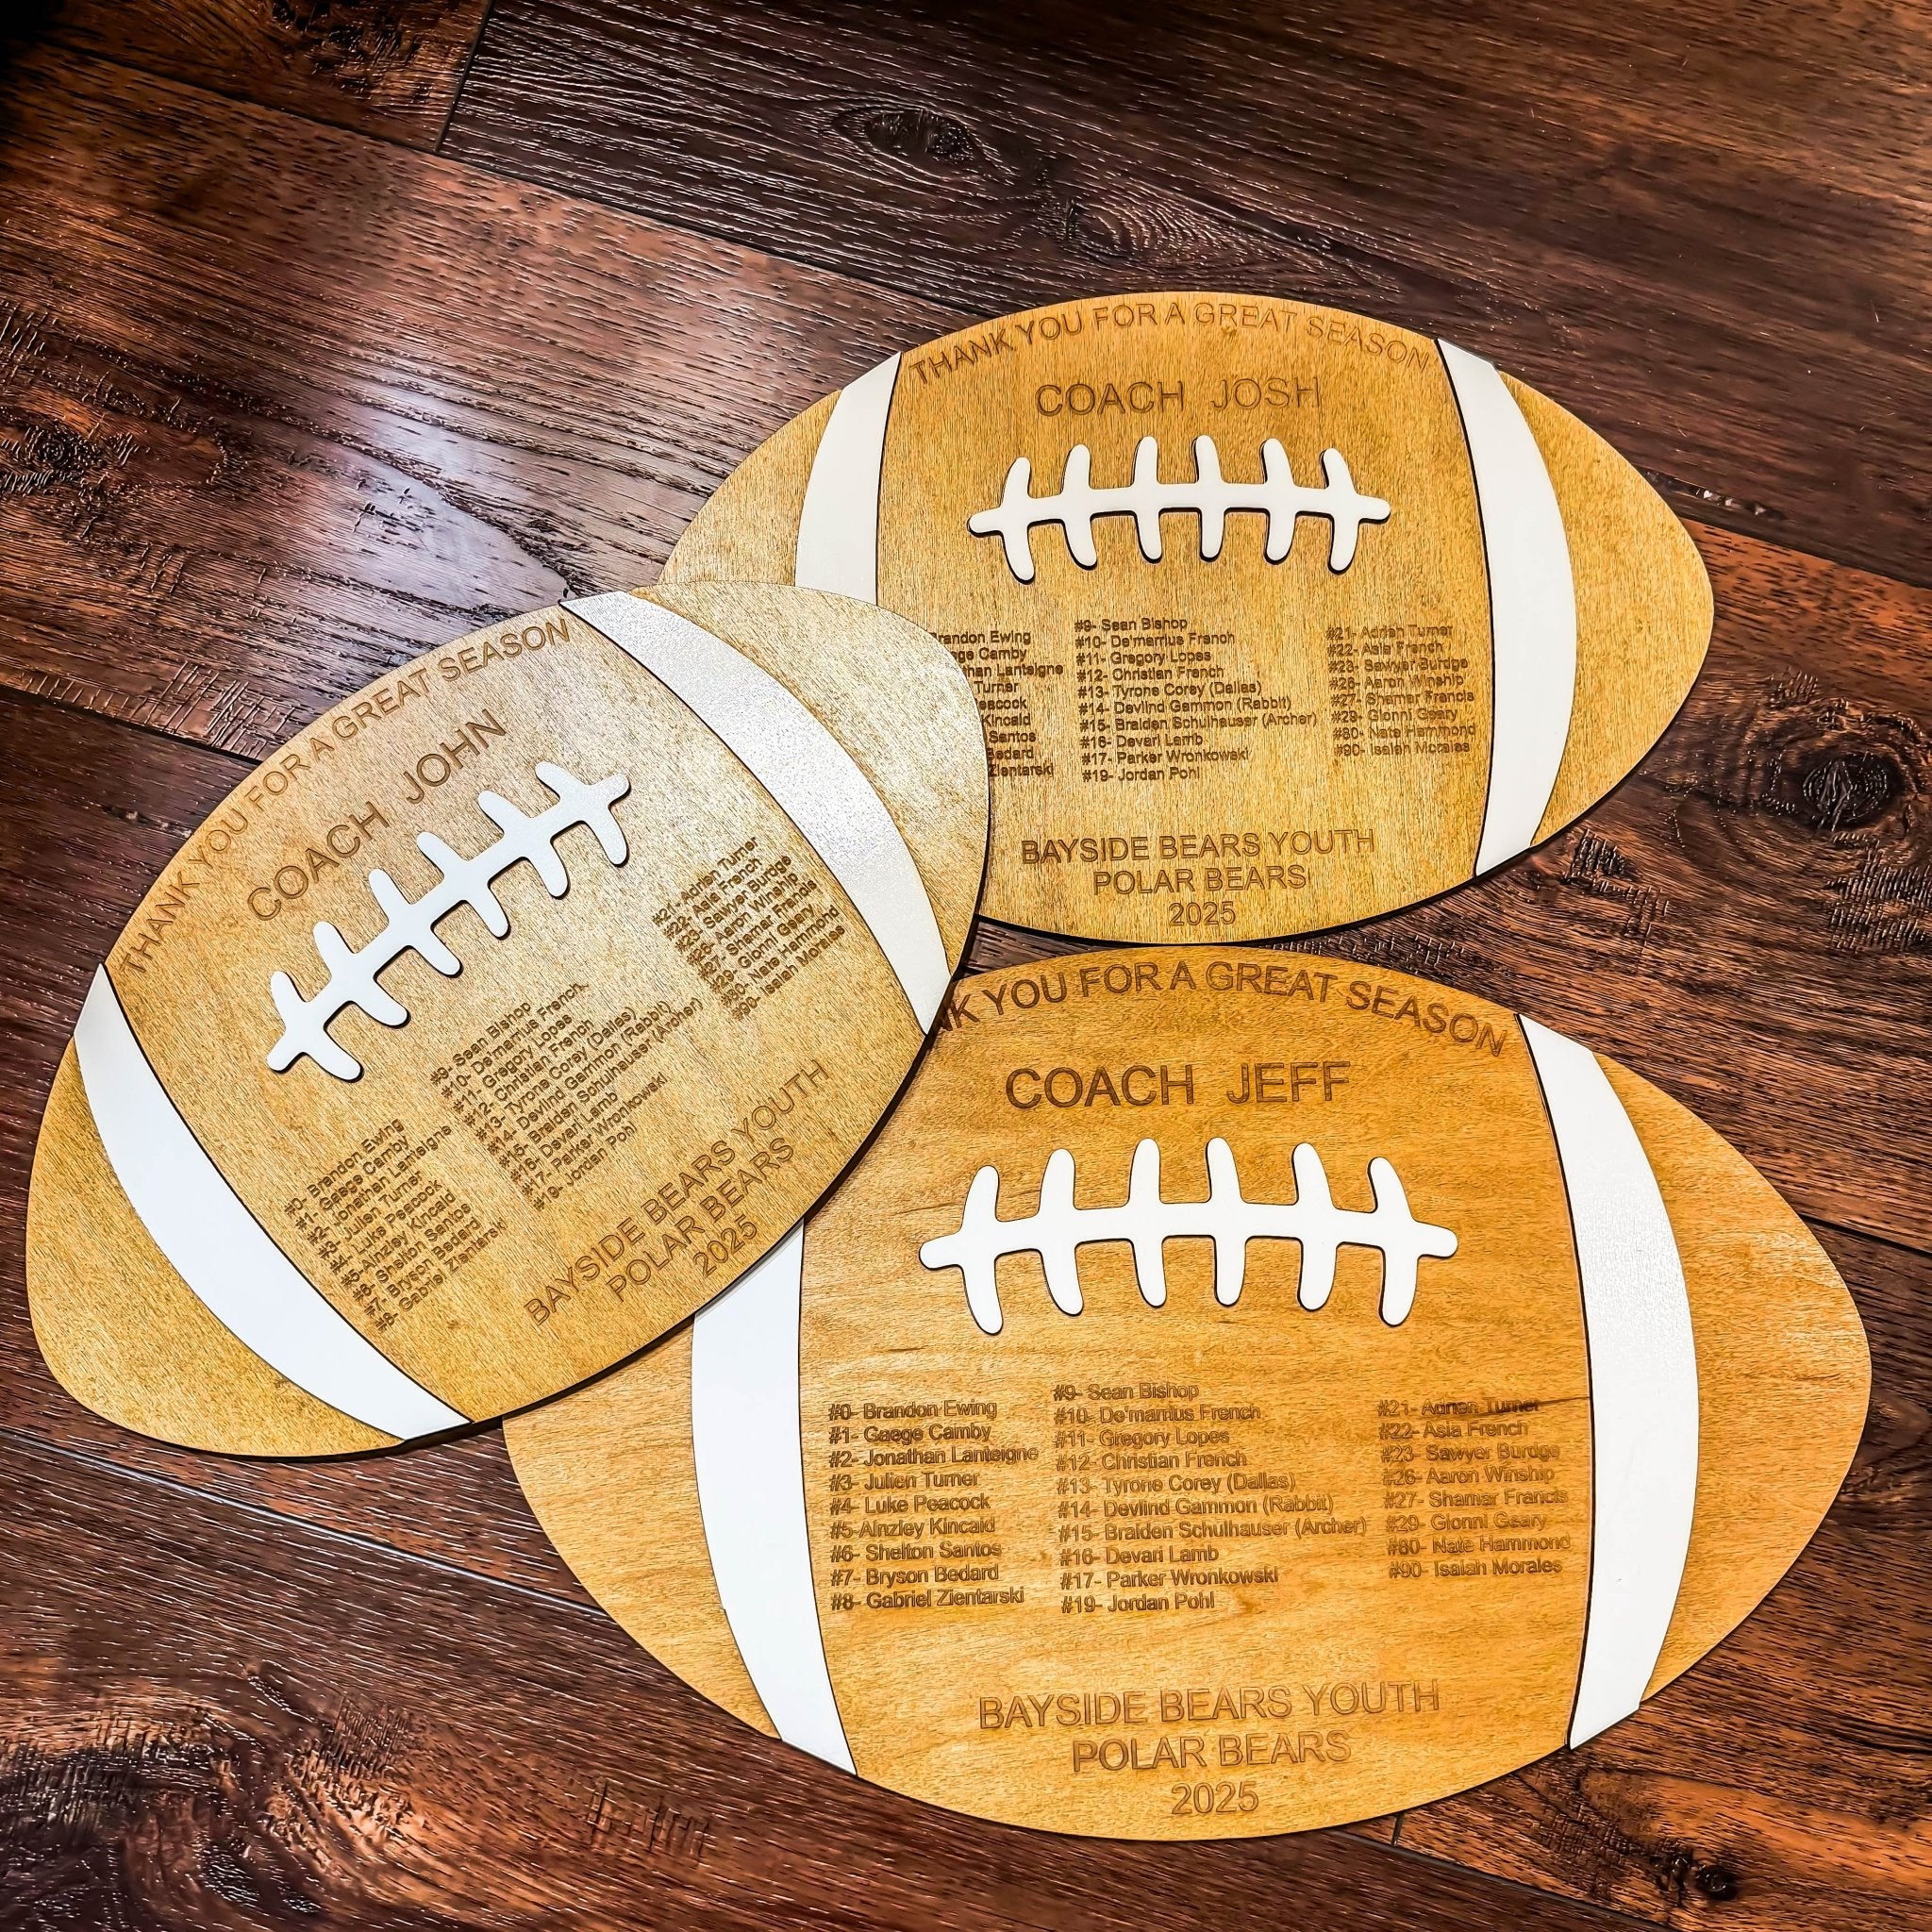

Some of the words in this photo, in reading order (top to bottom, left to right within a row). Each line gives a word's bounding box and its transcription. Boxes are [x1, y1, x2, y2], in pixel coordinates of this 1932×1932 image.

[908, 331, 1017, 385] THANK
[1016, 311, 1083, 345] YOU
[1092, 303, 1158, 331] FOR
[1166, 305, 1185, 324] A
[1194, 302, 1296, 334] GREAT
[1306, 315, 1429, 373] SEASON
[1038, 379, 1183, 417] COACH
[1210, 377, 1319, 410] JOSH
[122, 870, 199, 974] THANK
[189, 812, 248, 870] YOU
[243, 754, 310, 813] FOR
[310, 738, 336, 762] A
[331, 668, 433, 741] GREAT
[439, 619, 572, 683] SEASON
[246, 800, 390, 920] COACH
[401, 708, 507, 804] JOHN
[1022, 837, 1149, 864] BAYSIDE
[1159, 832, 1259, 860] BEARS
[1269, 829, 1374, 855] YOUTH
[1093, 869, 1194, 895] POLAR
[1205, 865, 1307, 891] BEARS
[1169, 901, 1236, 925] 2025
[981, 978, 1067, 1017] YOU
[1079, 961, 1163, 997] FOR
[1169, 961, 1196, 990] A
[1206, 961, 1338, 1003] GREAT
[1346, 982, 1507, 1057] SEASON
[1005, 1064, 1194, 1108] COACH
[1226, 1060, 1350, 1105] JEFF
[523, 1217, 644, 1325] BAYSIDE
[641, 1140, 736, 1225] BEARS
[731, 1059, 829, 1143] YOUTH
[606, 1215, 706, 1303] POLAR
[700, 1138, 793, 1223] BEARS
[693, 1214, 758, 1277] 2025
[1088, 1384, 1133, 1400] Sean
[1140, 1382, 1199, 1401] Bishop
[864, 1402, 938, 1419] Brandon
[944, 1400, 997, 1418] Ewing
[1200, 1404, 1260, 1420] French
[1483, 1397, 1540, 1413] Turner
[929, 1423, 991, 1441] Camby
[1099, 1429, 1170, 1449] Gregory
[1176, 1428, 1229, 1446] Lopes
[1424, 1421, 1461, 1438] Asia
[1468, 1420, 1528, 1436] French
[864, 1448, 945, 1466] Jonathan
[952, 1446, 1039, 1464] Lanteigne
[1102, 1452, 1179, 1470] Christian
[1186, 1451, 1247, 1467] French
[1425, 1444, 1491, 1463] Sawyer
[1497, 1442, 1560, 1461] Burdge
[865, 1473, 916, 1490] Julien
[923, 1472, 979, 1488] Turner
[1103, 1477, 1162, 1494] Tyrone
[1169, 1474, 1221, 1493] Corey
[1226, 1473, 1295, 1493] (Dallas)
[1426, 1467, 1479, 1484] Aaron
[1485, 1466, 1555, 1484] Winship
[865, 1496, 908, 1514] Luke
[914, 1493, 991, 1512] Peacock
[1175, 1497, 1257, 1516] Gammon
[1262, 1495, 1334, 1516] (Rabbit)
[1429, 1490, 1498, 1507] Shamar
[1505, 1489, 1568, 1504] Francis
[930, 1517, 995, 1535] Kincaid
[1105, 1523, 1173, 1541] Braiden
[1179, 1520, 1289, 1539] Schulhauser
[1295, 1518, 1367, 1539] (Archer)
[1494, 1511, 1546, 1530] Geary
[866, 1542, 933, 1561] Shelton
[940, 1541, 1002, 1557] Santos
[1170, 1545, 1218, 1562] Lamb
[1433, 1537, 1474, 1554] Nate
[1480, 1533, 1571, 1551] Hammond
[866, 1568, 928, 1588] Bryson
[935, 1563, 998, 1582] Bedard
[1435, 1559, 1487, 1576] Isaiah
[1492, 1557, 1562, 1574] Morales
[1107, 1570, 1166, 1588] Parker
[1171, 1567, 1278, 1586] Wronkowski
[867, 1590, 931, 1608] Gabriel
[937, 1587, 1024, 1606] Zientarski
[1108, 1593, 1169, 1612] Jordan
[1175, 1591, 1215, 1609] Pohl
[979, 1691, 1147, 1729] BAYSIDE
[1160, 1685, 1291, 1722] BEARS
[1302, 1678, 1440, 1715] YOUTH
[1073, 1736, 1207, 1772] POLAR
[1219, 1730, 1351, 1767] BEARS
[1171, 1781, 1259, 1816] 2025
